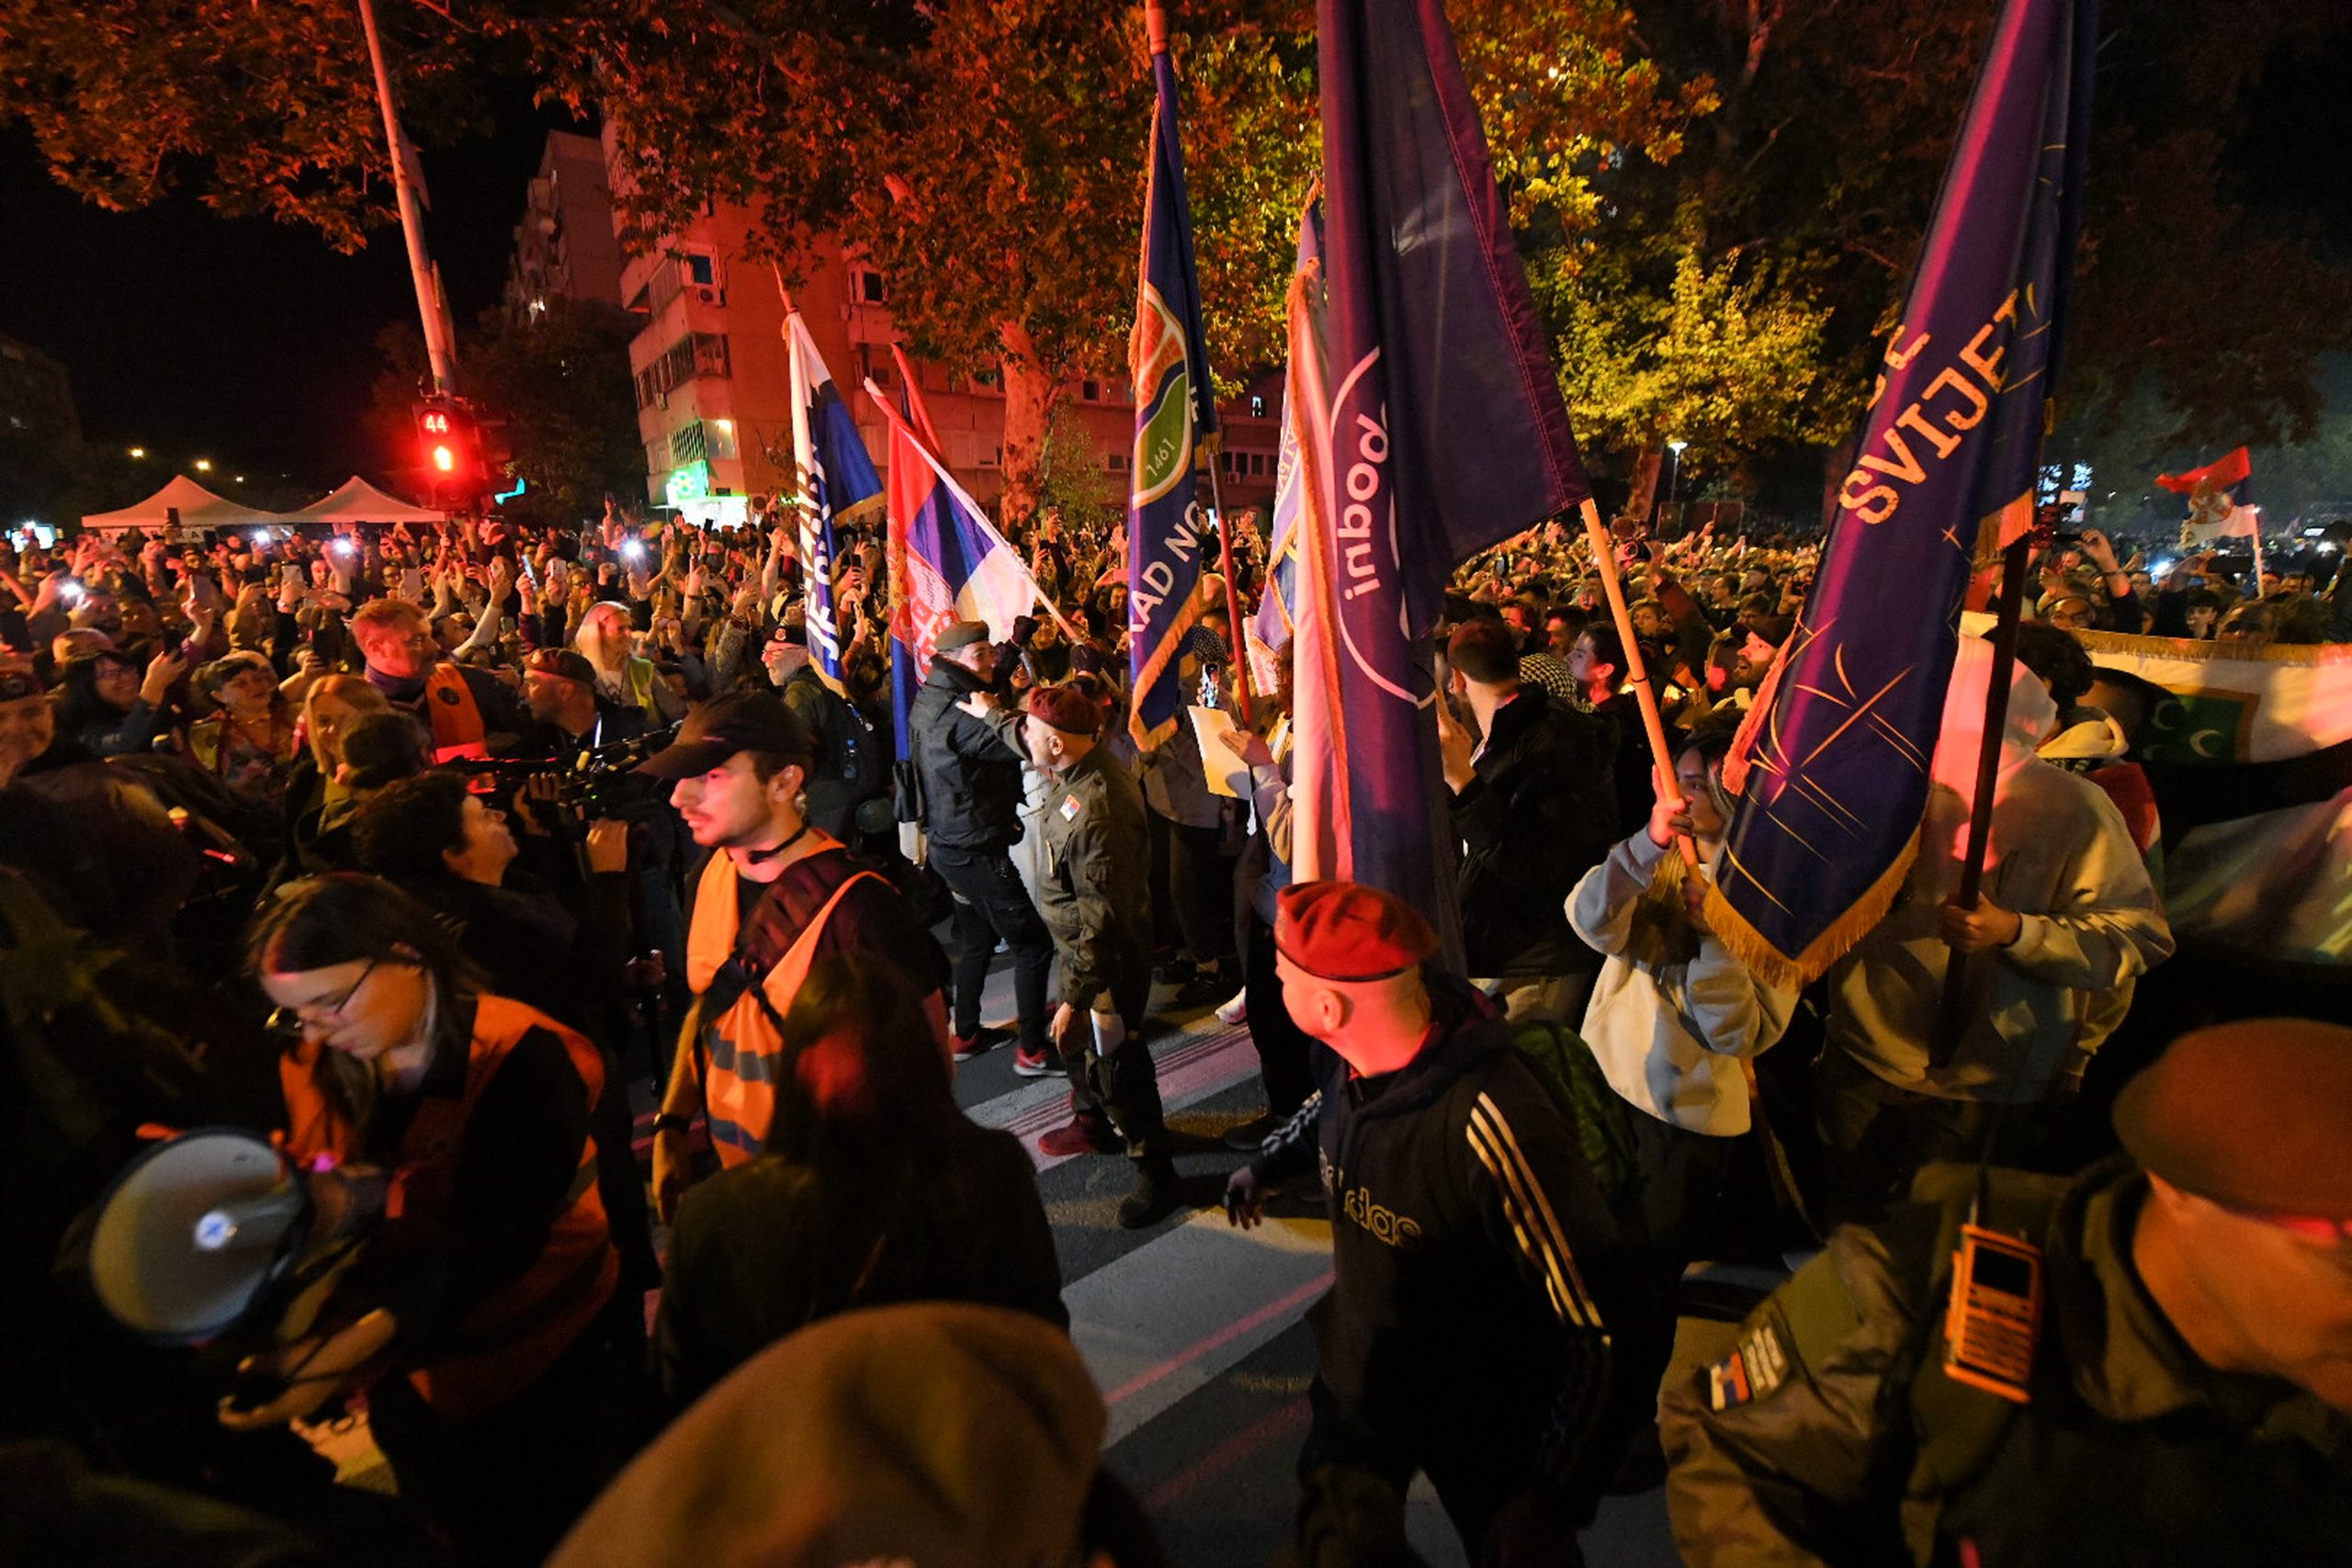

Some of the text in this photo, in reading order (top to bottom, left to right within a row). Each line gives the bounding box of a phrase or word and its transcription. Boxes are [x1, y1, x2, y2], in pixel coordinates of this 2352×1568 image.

[425, 414, 448, 433] 44
[1146, 437, 1175, 477] 1461
[1337, 413, 1388, 601] inbod
